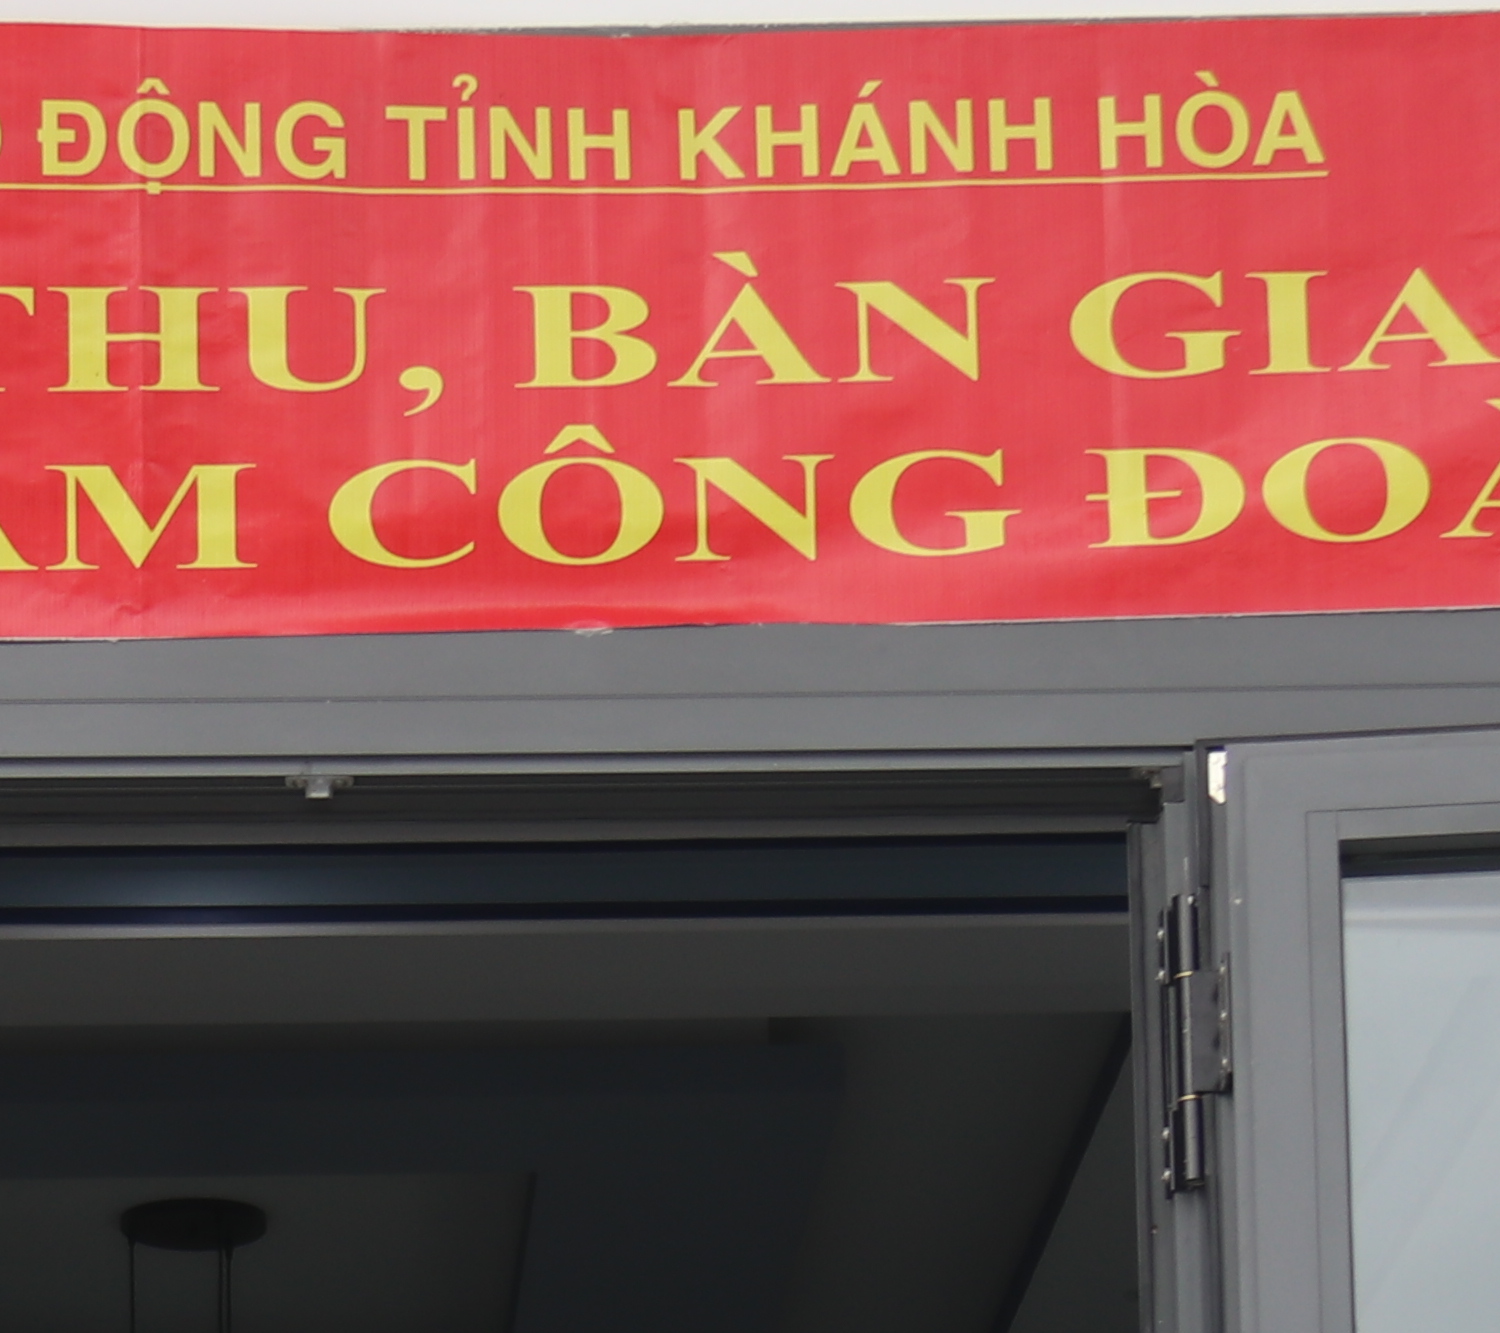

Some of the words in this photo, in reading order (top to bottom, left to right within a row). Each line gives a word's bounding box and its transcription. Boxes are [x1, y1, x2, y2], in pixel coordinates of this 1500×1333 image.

[34, 75, 348, 194] ĐỘNG
[383, 71, 634, 183] TỈNH
[676, 78, 1056, 182] KHÁNH
[1096, 68, 1328, 172] HÒA
[513, 249, 997, 389] BÀN
[326, 422, 1022, 570] CÔNG
